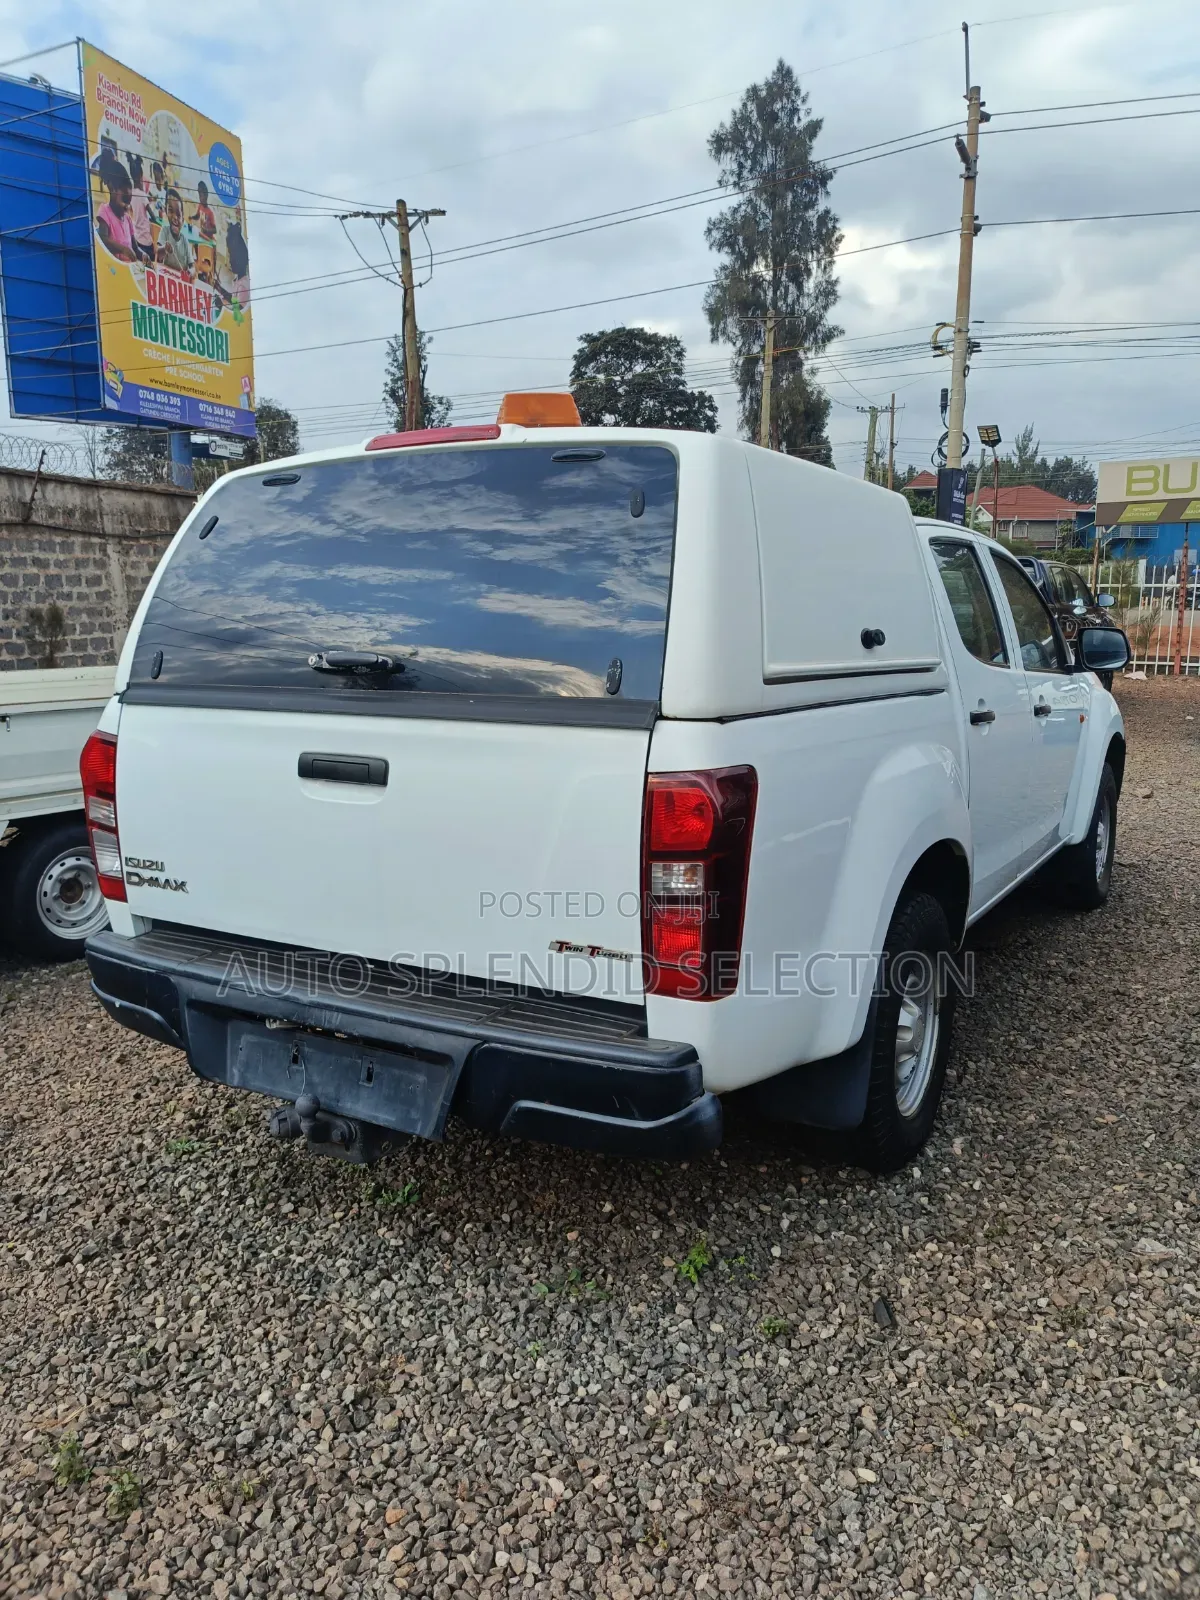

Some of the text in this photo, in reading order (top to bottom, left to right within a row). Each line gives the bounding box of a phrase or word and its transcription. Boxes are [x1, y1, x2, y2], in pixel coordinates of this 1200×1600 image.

[98, 73, 129, 102] Kiambu
[97, 87, 147, 126] Branch Now
[105, 109, 142, 143] enrolling
[146, 270, 213, 324] BARNLEY
[131, 301, 229, 363] MONTESSORI
[165, 366, 206, 383] PRE SCHOOL
[176, 357, 224, 377] KINDERGARTEN
[138, 388, 181, 407] 0748 036 393
[198, 403, 213, 414] 0716
[1126, 462, 1199, 496] BU
[124, 856, 165, 872] ISUZU
[125, 871, 189, 893] D-MAX
[555, 940, 629, 960] TWIN TURBO
